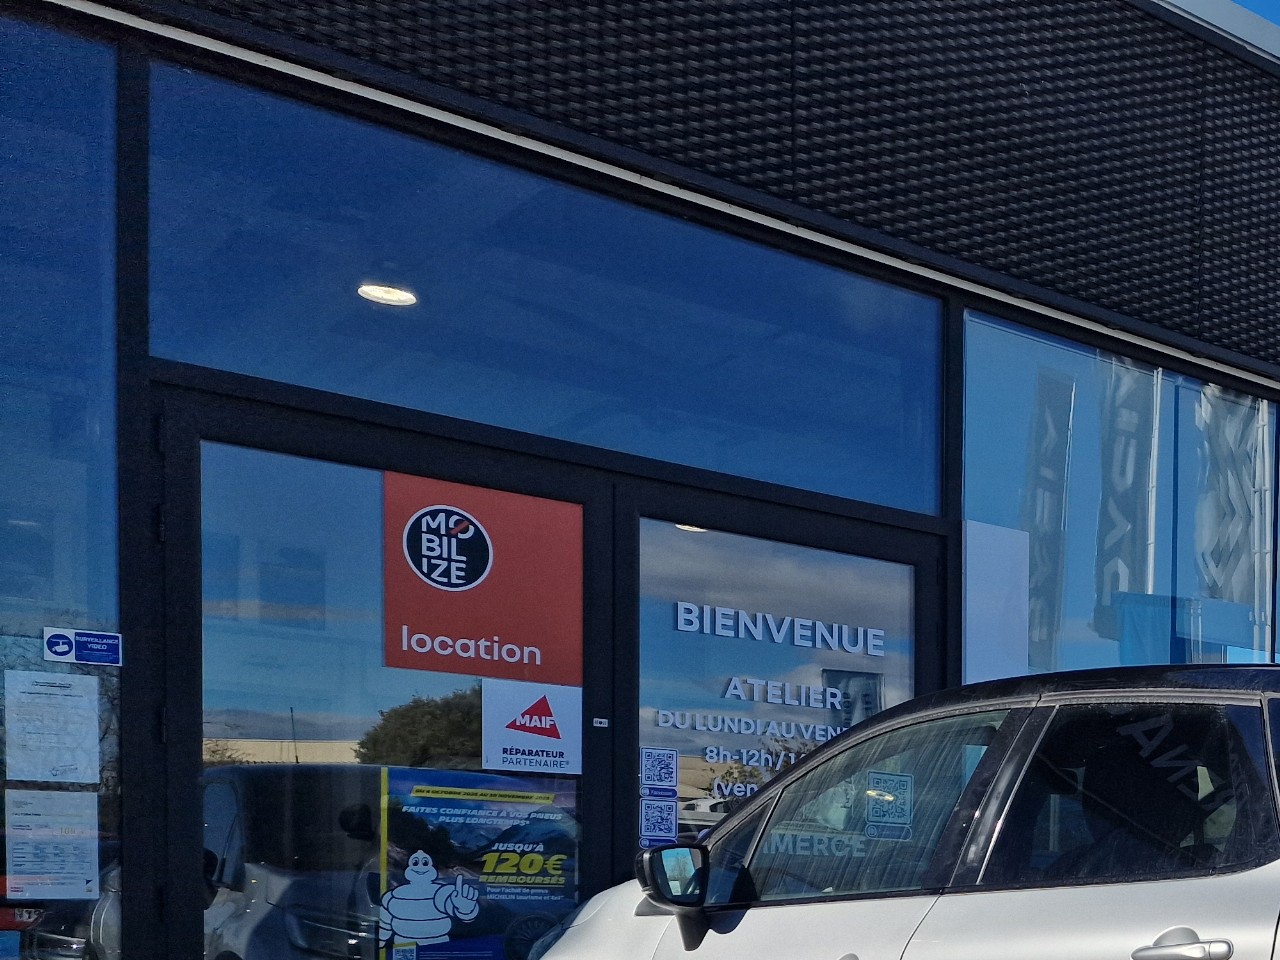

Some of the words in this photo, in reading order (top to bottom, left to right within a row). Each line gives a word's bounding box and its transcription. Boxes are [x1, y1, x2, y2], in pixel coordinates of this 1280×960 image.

[675, 600, 885, 657] BIENVENUE
[402, 624, 542, 666] location
[723, 676, 843, 710] ATELIER
[515, 714, 556, 729] MAIF
[657, 710, 690, 730] DU
[694, 712, 761, 736] LUNDI
[765, 720, 796, 739] AU
[799, 723, 849, 742] VEN
[502, 746, 565, 759] RÉPARATEUR
[704, 745, 773, 768] 8h-12h
[402, 805, 438, 814] FAITES
[440, 807, 499, 817] CONFIANCE
[530, 812, 563, 820] PNEUS
[438, 815, 464, 824] PLUS
[491, 842, 544, 853] JUSQU'À
[481, 852, 568, 875] 120€
